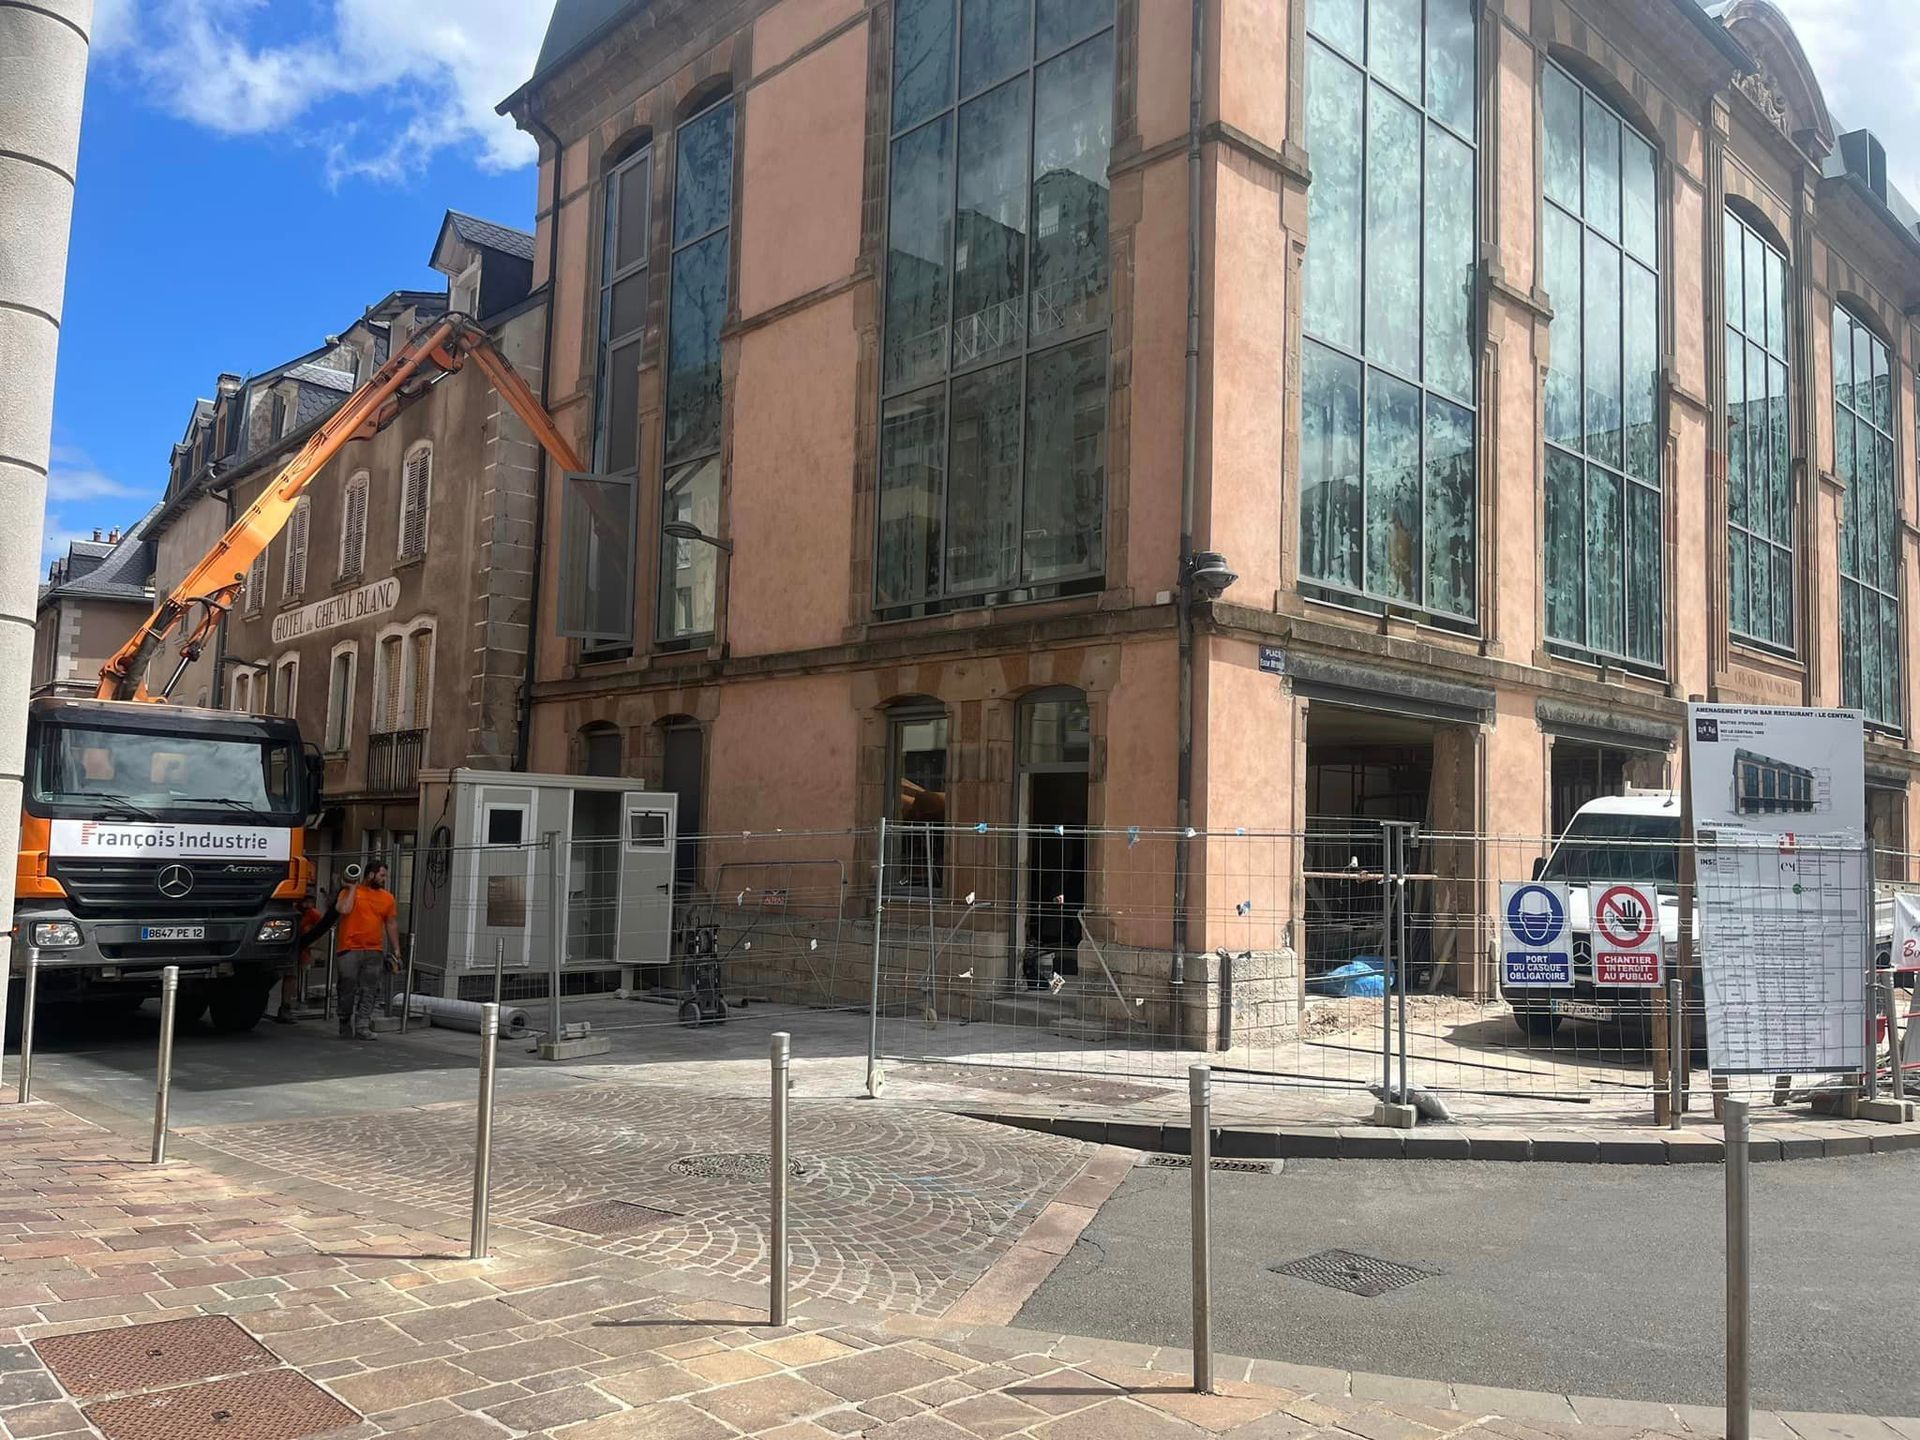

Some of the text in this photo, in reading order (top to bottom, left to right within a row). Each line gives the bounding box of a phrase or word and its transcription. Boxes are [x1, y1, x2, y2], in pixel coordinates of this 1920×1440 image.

[275, 610, 305, 641] HOTEL
[315, 593, 354, 629] CHEVAL
[356, 582, 395, 617] BLANC
[1695, 707, 1742, 715] AMENAGEMENT
[1773, 710, 1813, 718] RESTAURANT
[81, 822, 268, 850] François Industrie
[148, 928, 203, 938] 8647 PE 12
[1525, 955, 1549, 963] PORT
[1603, 956, 1652, 964] CHANTIER
[1513, 964, 1562, 973] DU CASQUE
[1606, 965, 1650, 973] INTERDIT
[1509, 971, 1566, 981] OBLIGATOIRE
[1603, 972, 1654, 981] AU PUBLIC
